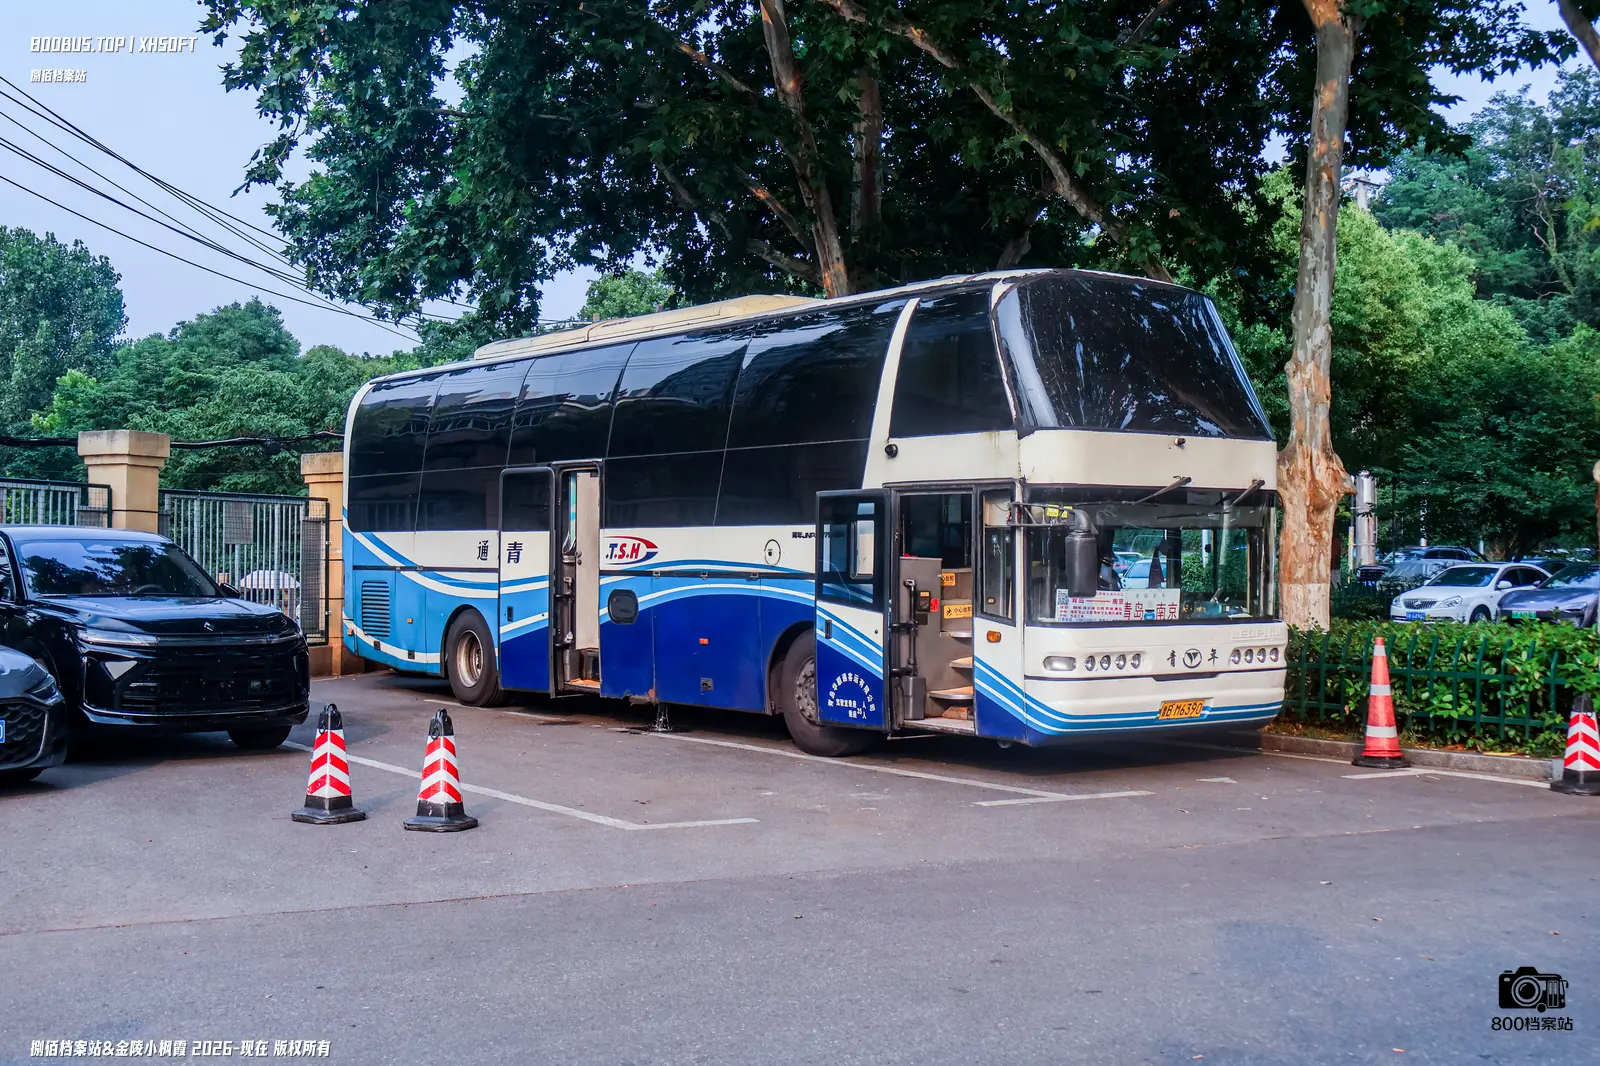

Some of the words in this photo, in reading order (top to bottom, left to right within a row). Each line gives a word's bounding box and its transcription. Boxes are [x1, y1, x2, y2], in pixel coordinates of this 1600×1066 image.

[476, 540, 489, 561] 通
[506, 541, 523, 564] 青
[1123, 602, 1144, 621] 青岛
[1156, 602, 1178, 621] 南京
